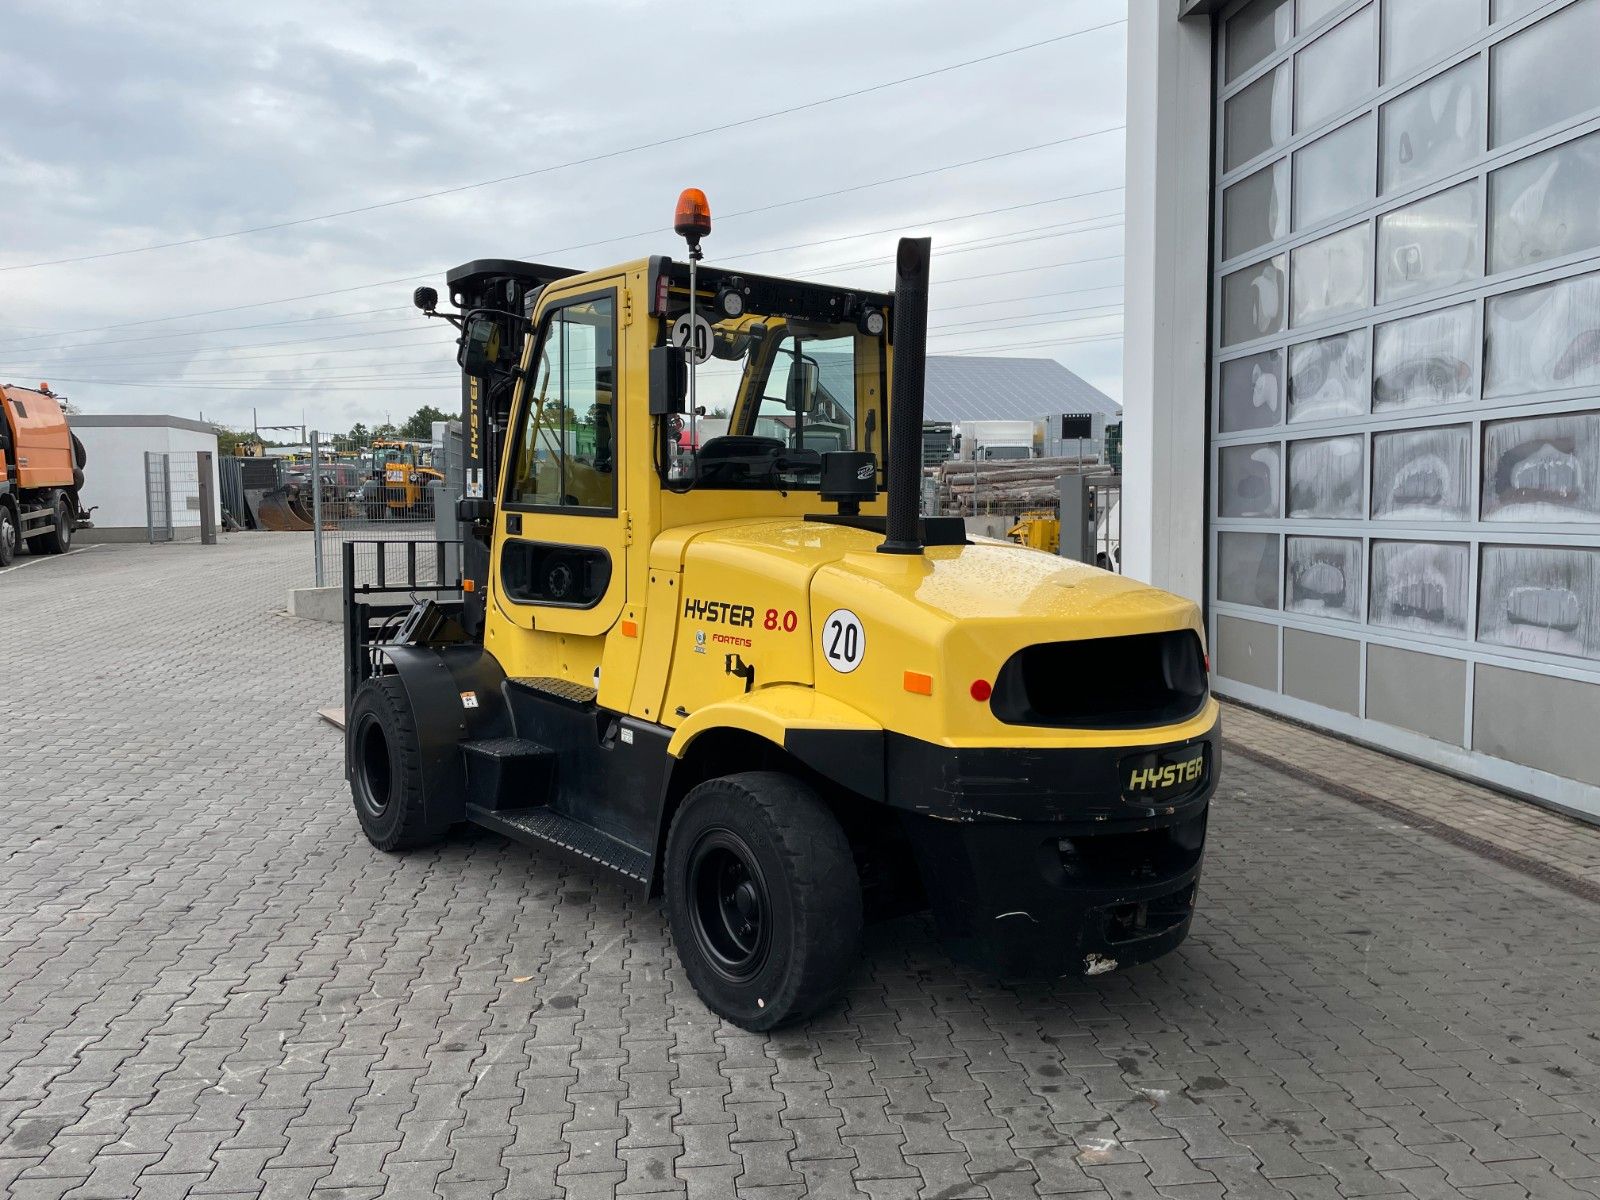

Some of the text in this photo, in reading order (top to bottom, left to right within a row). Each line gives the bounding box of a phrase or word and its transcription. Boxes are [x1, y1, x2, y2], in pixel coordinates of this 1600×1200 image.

[684, 598, 798, 632] HYSTER 8.0
[712, 633, 752, 648] FORTENS
[829, 620, 858, 662] 20
[1129, 756, 1203, 791] HYSTER
